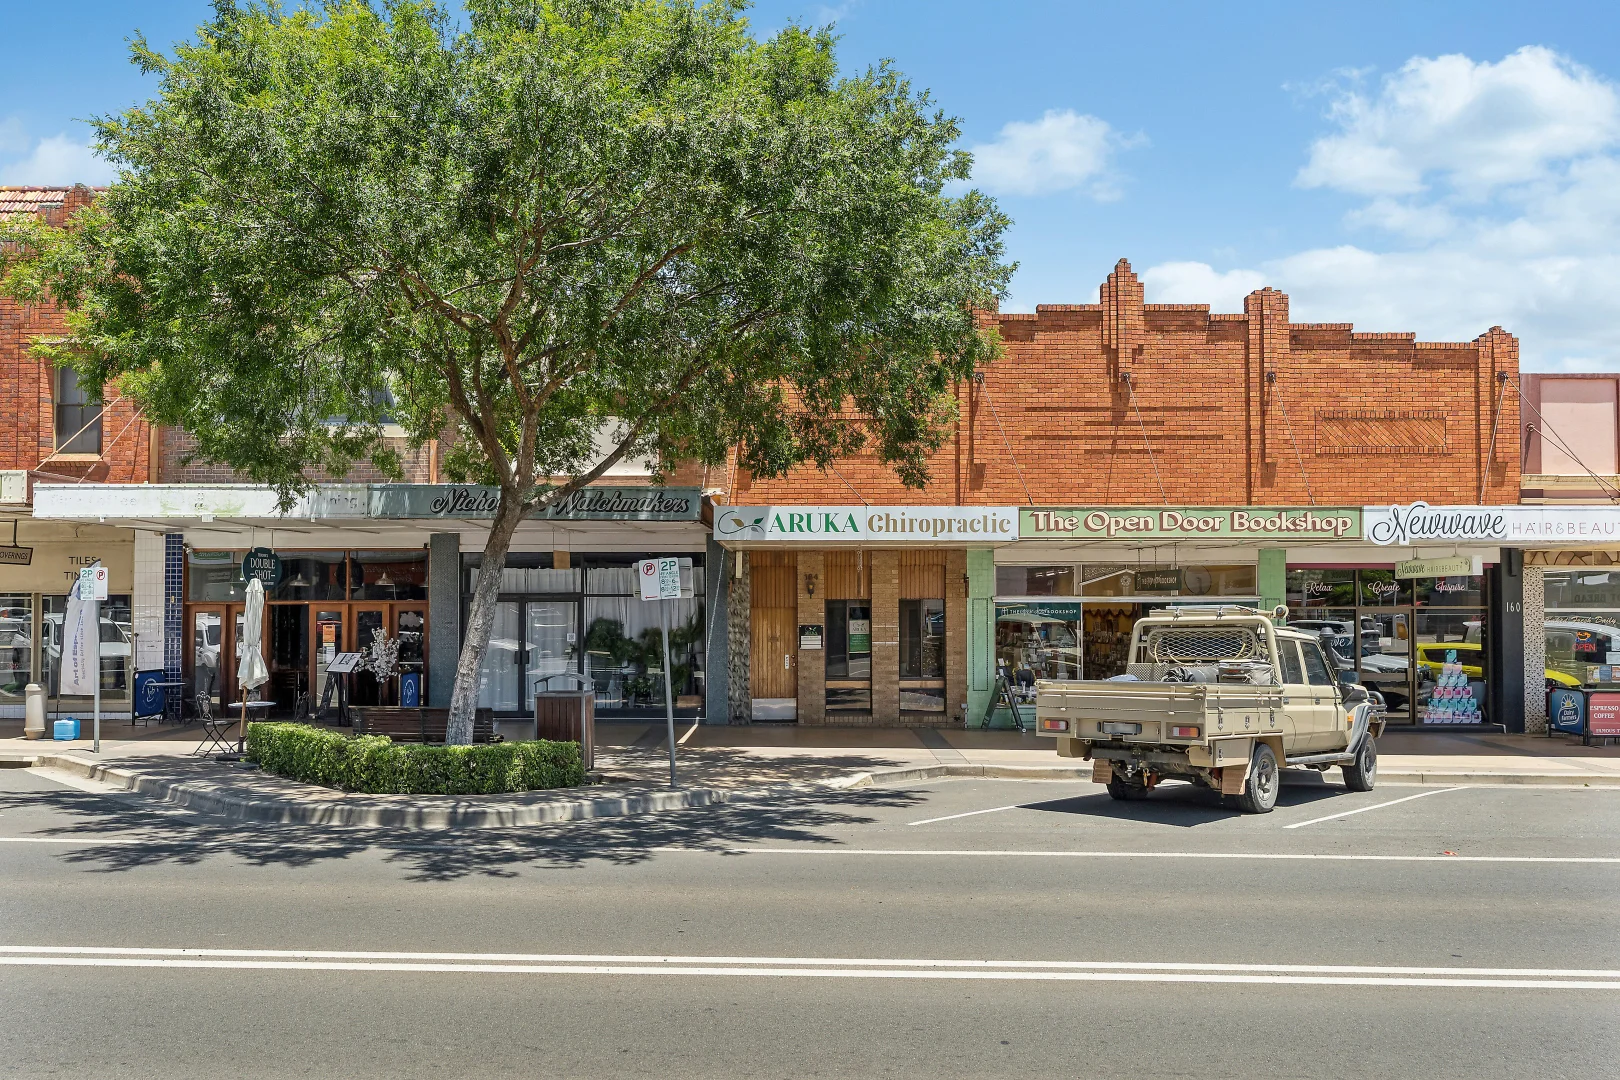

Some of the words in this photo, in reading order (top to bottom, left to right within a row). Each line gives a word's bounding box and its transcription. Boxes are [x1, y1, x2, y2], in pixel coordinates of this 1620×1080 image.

[552, 489, 690, 516] Watchmakers
[768, 512, 860, 533] ARUKA
[867, 511, 1011, 538] Chiropractic
[1029, 510, 1079, 533] The
[1084, 510, 1154, 538] Open
[1159, 510, 1225, 533] Door
[1230, 510, 1353, 539] Bookshop
[1372, 504, 1506, 542] Newwave
[68, 556, 97, 565] TILES
[250, 558, 276, 569] DOUBLE
[660, 560, 677, 571] 2P
[81, 569, 93, 578] 2P
[254, 570, 272, 580] SHOT
[1304, 580, 1333, 596] Relax
[1367, 580, 1401, 596] Create
[1434, 580, 1466, 594] Inspire
[1506, 601, 1521, 613] 160
[1571, 643, 1596, 652] OPEN
